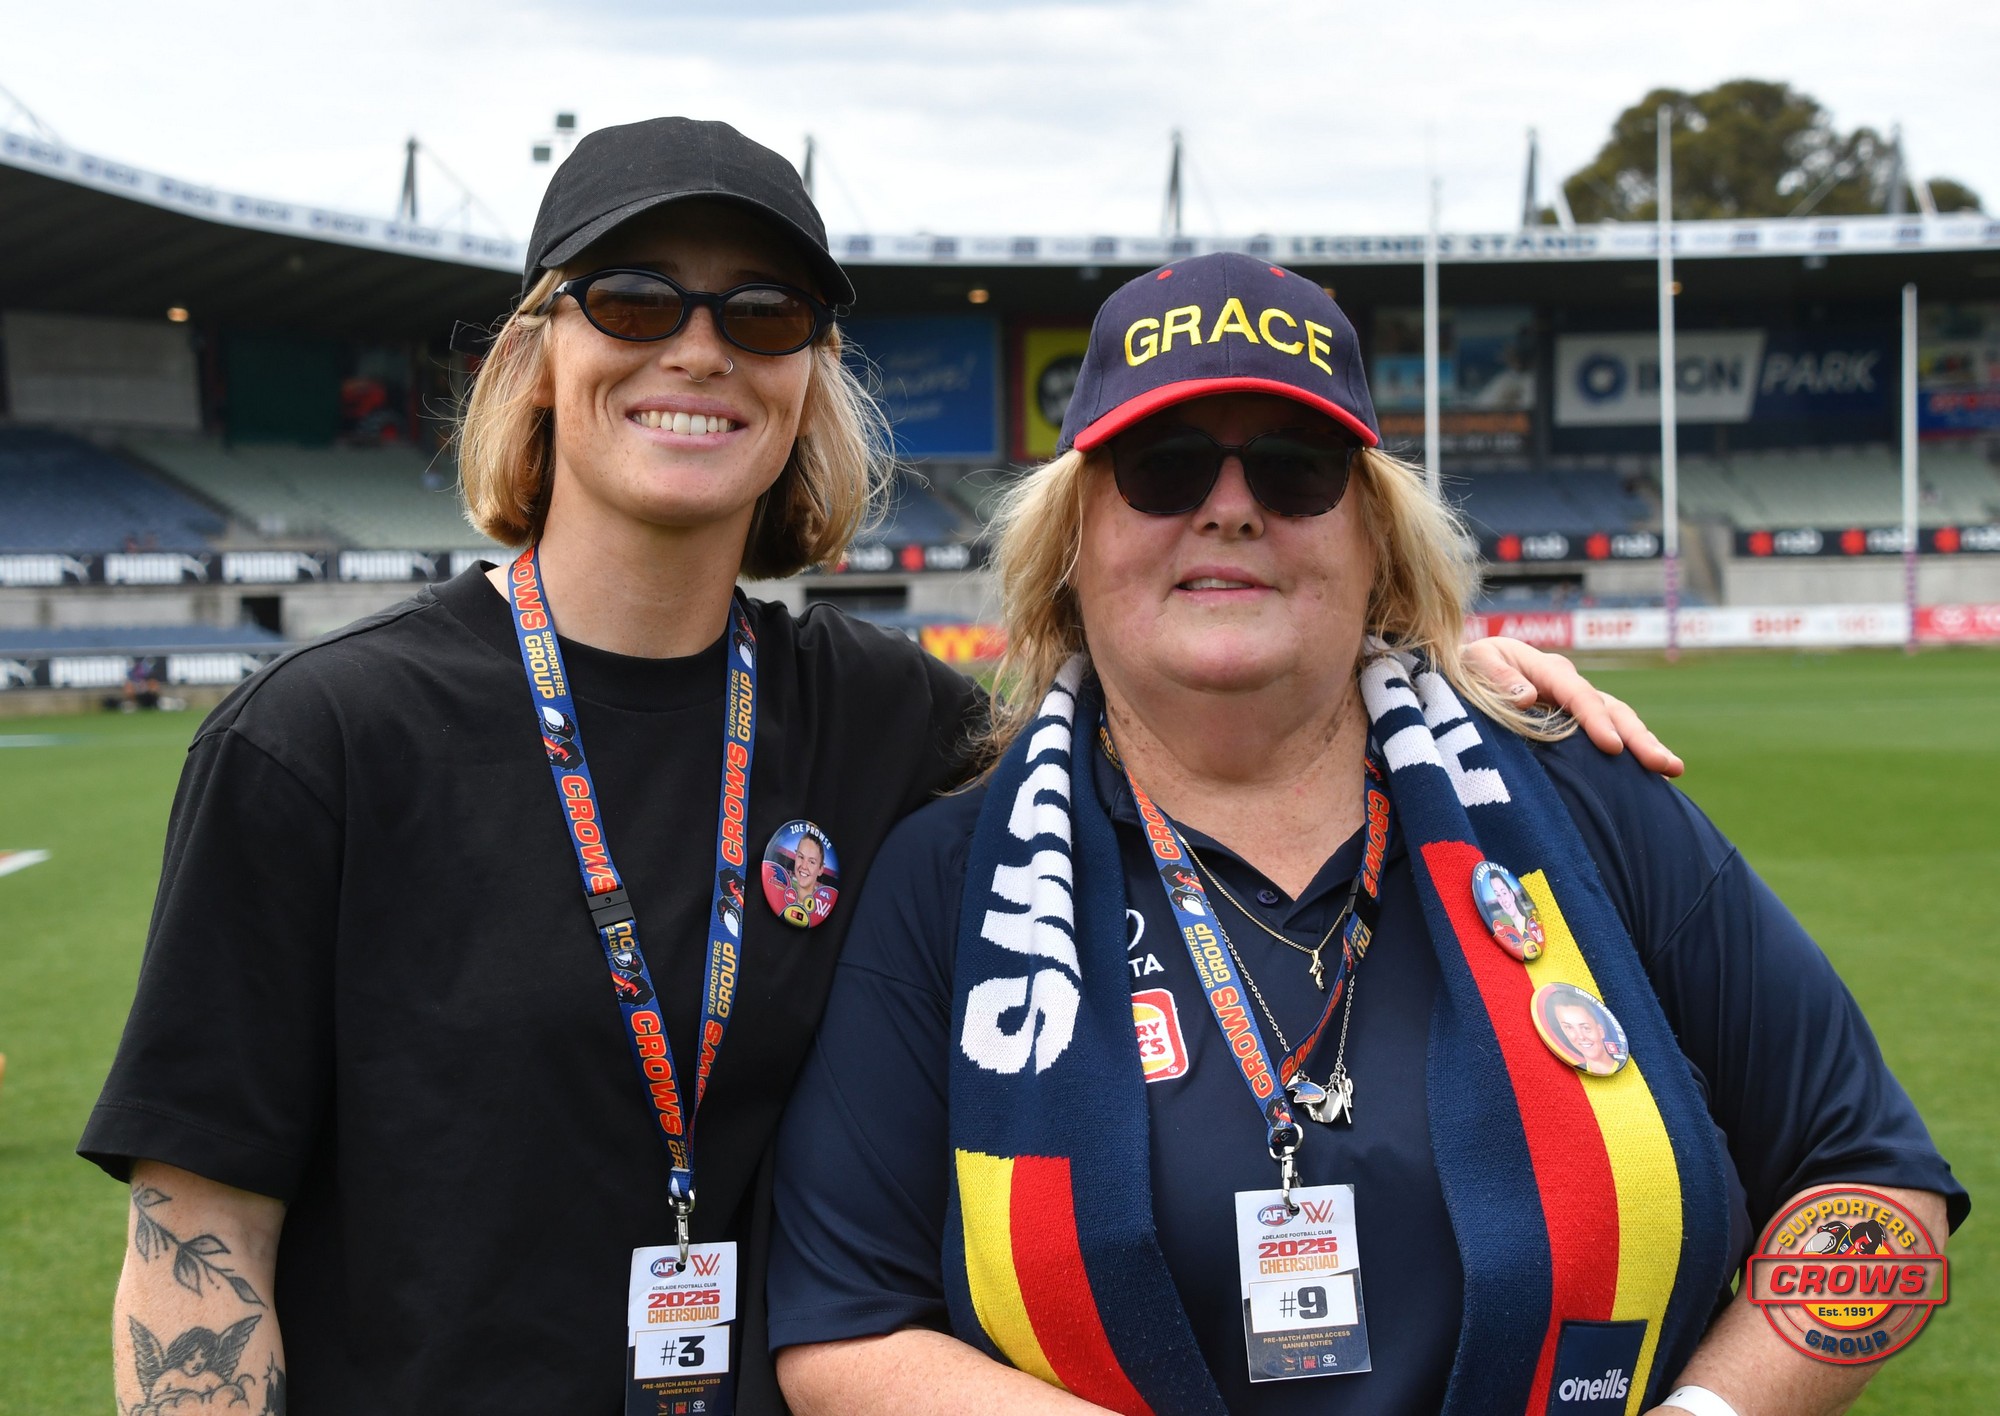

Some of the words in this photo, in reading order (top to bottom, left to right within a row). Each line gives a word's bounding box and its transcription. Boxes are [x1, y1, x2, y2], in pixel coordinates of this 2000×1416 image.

[1124, 297, 1335, 377] GRACE
[1634, 354, 1742, 394] ION
[1761, 349, 1878, 395] PARK
[0, 554, 63, 586] UMA
[513, 545, 548, 632] ROWS
[525, 634, 555, 700] GROUP
[542, 631, 566, 697] SUPPORTERS
[728, 668, 740, 738] SUPPORTERS
[736, 672, 754, 742] GROUP
[561, 775, 618, 895] CROWS
[721, 741, 748, 867] CROWS
[1125, 766, 1182, 861] CROW
[790, 823, 804, 835] ZOE
[805, 824, 832, 850] PROWSE
[1363, 789, 1390, 899] CROWS
[708, 940, 722, 1015] SUPPORTERS
[716, 942, 734, 1018] GROUP
[1183, 926, 1215, 989] SUPPORTERS
[1194, 923, 1231, 983] GROUP
[631, 1010, 683, 1136] CROWS
[1210, 985, 1274, 1099] CROWS
[1258, 1237, 1338, 1258] 2025
[1259, 1254, 1339, 1275] CHEERSQUAD
[648, 1289, 720, 1309] 2025
[648, 1306, 719, 1324] CHEERSQUAD
[1279, 1285, 1329, 1320] #9
[660, 1335, 705, 1367] #3
[1263, 1335, 1301, 1344] PRE-MATCH
[1302, 1333, 1324, 1341] ARENA
[1324, 1330, 1351, 1338] ACCESS
[642, 1382, 677, 1390] PRE-MATCH
[683, 1386, 705, 1394] DUTIES
